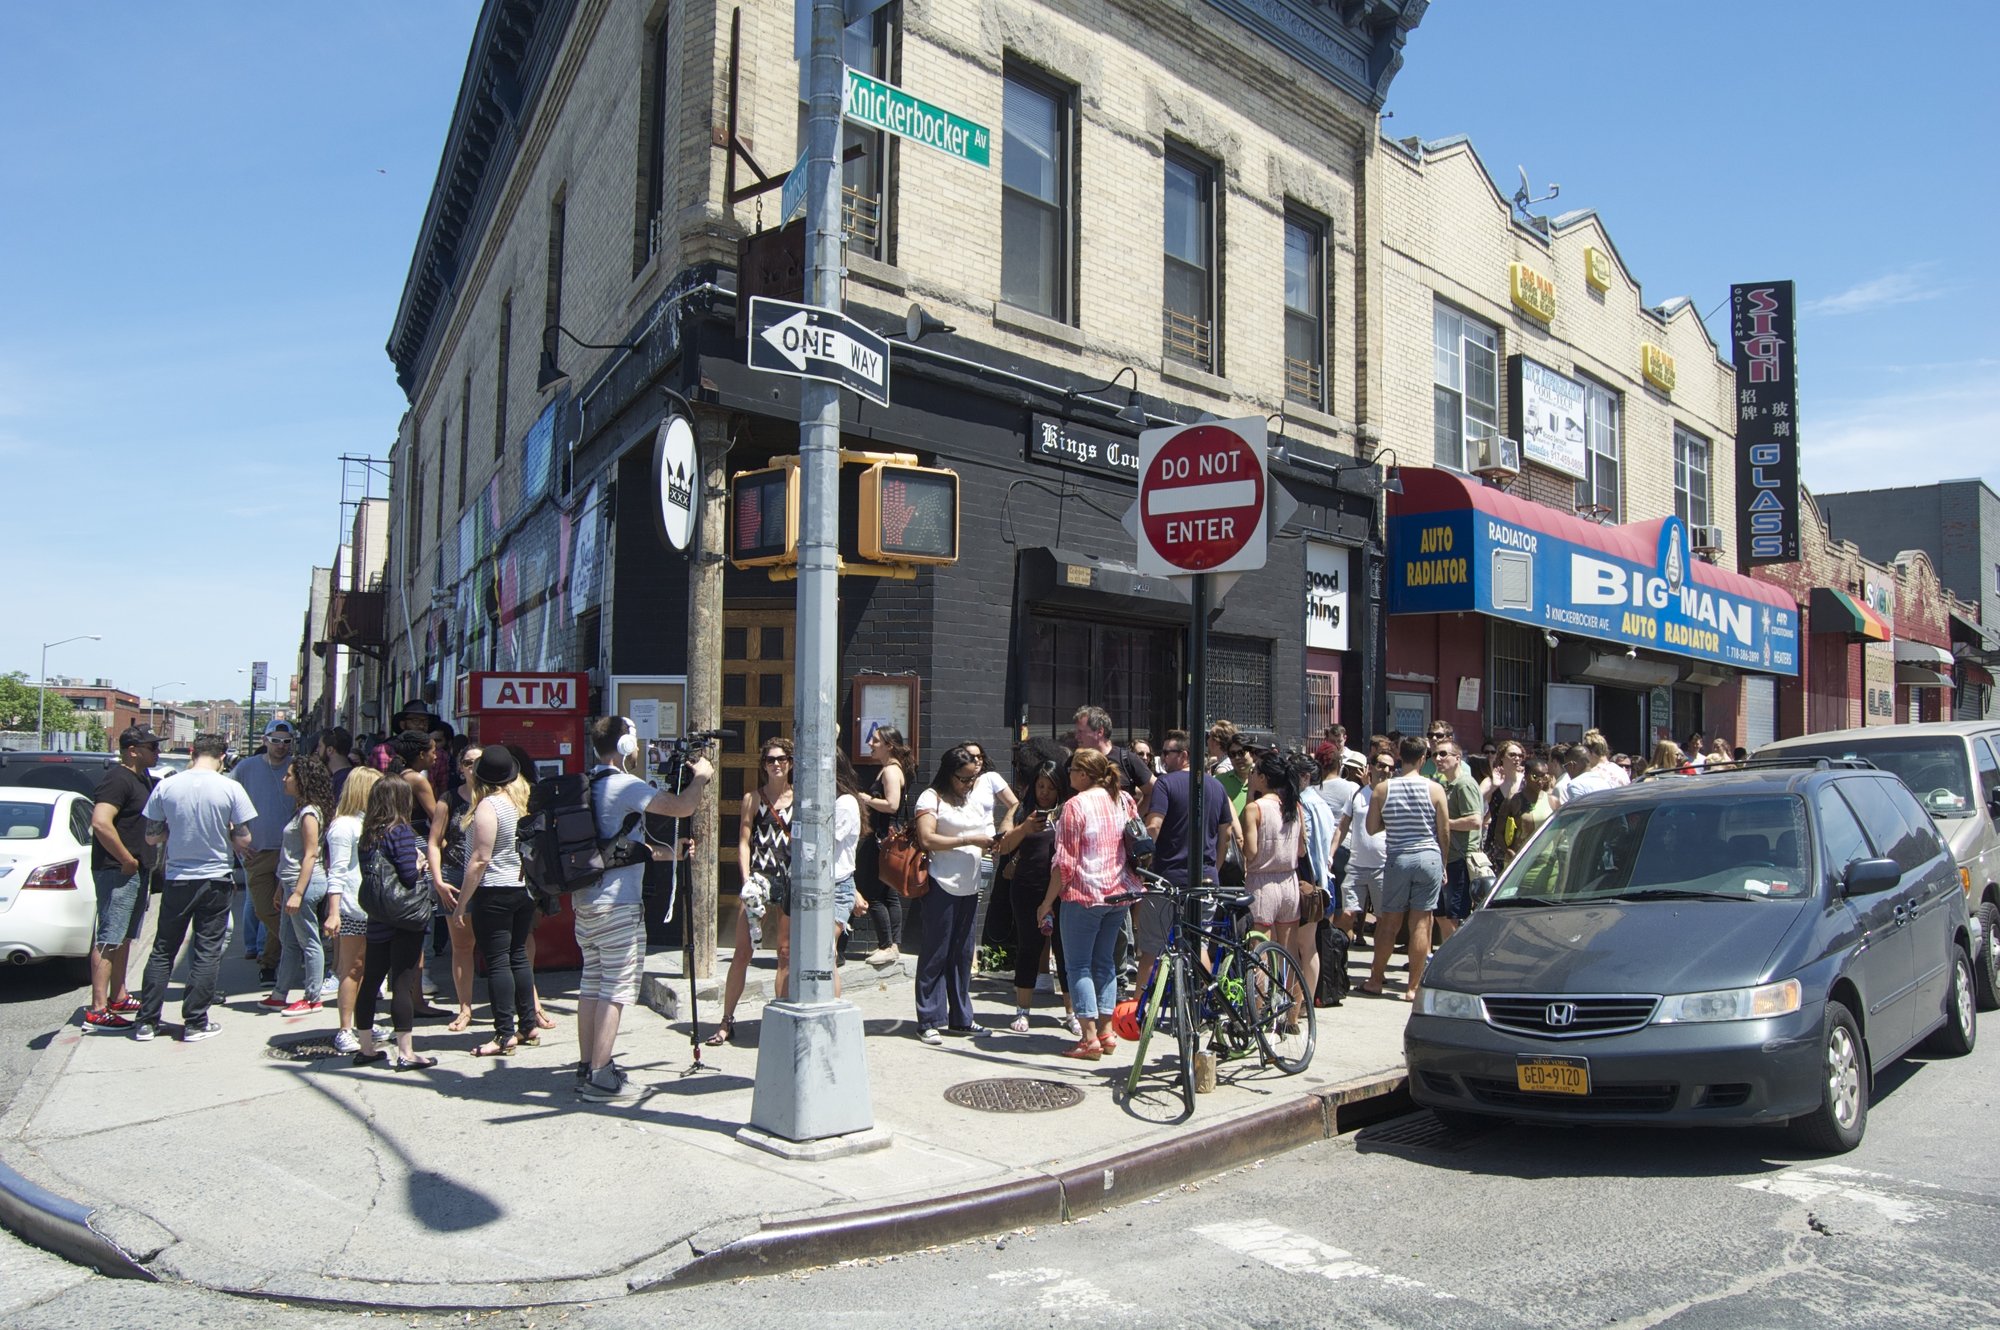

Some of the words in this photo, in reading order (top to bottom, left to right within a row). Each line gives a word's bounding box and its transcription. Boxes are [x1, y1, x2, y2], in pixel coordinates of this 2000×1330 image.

[848, 77, 969, 156] Knickerbocker
[974, 129, 987, 149] Av
[1734, 288, 1743, 337] GOTHAM
[782, 326, 835, 359] ONE
[851, 343, 877, 378] WAY
[1041, 423, 1097, 462] Kings
[1107, 442, 1139, 470] Cou
[1162, 457, 1190, 480] DO
[1199, 451, 1241, 476] NOT
[1748, 443, 1785, 558] GLASS
[1166, 517, 1235, 544] ENTER
[1421, 526, 1453, 553] AUTO
[1488, 521, 1538, 553] RADIATOR
[1788, 532, 1796, 557] INC
[1306, 570, 1339, 592] good
[1407, 558, 1467, 587] RADIATOR
[1571, 553, 1668, 608] BIG
[1680, 586, 1752, 646] MAN
[1545, 603, 1551, 619] 3
[1551, 607, 1599, 629] KNICKERBOCKER
[1776, 612, 1788, 626] AIR
[1621, 611, 1657, 640] AUTO
[1664, 622, 1720, 653] RADIATOR
[1773, 650, 1792, 666] HEATERS
[496, 681, 567, 704] ATM
